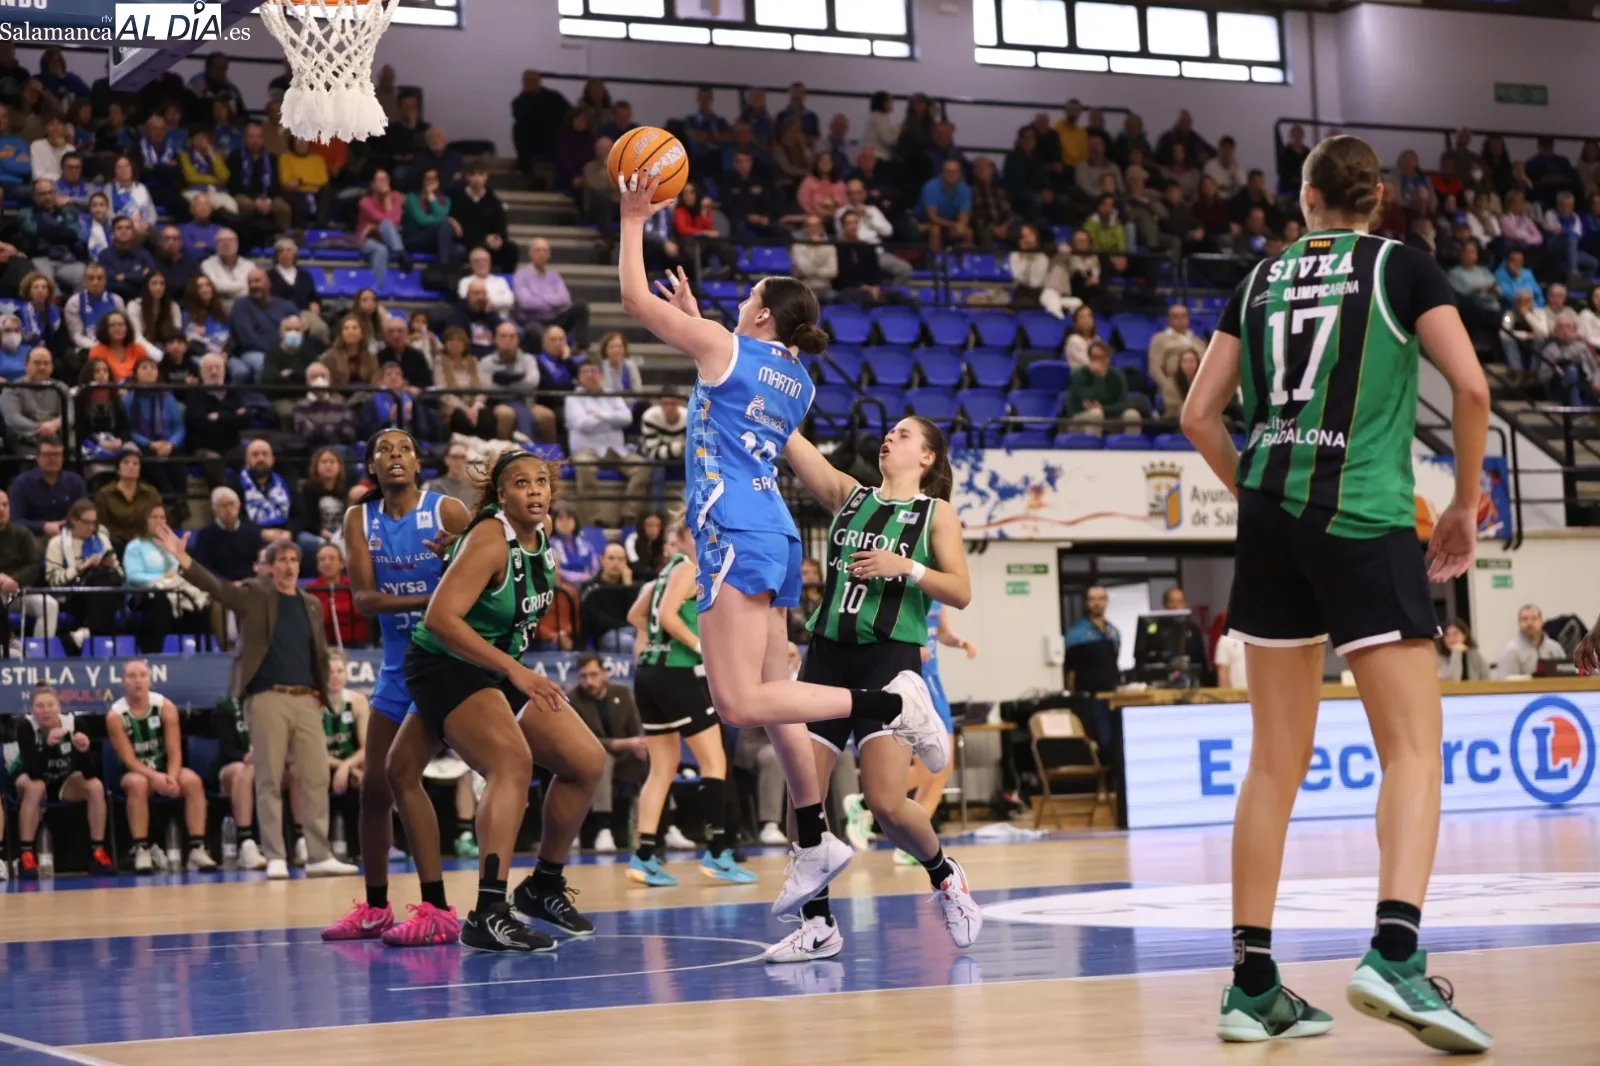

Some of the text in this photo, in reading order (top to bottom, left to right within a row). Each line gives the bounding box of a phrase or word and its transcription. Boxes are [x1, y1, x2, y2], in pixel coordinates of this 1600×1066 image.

[1266, 251, 1354, 283] SIVKA
[1268, 304, 1339, 406] 17
[758, 366, 802, 399] MARTÍN
[1260, 428, 1345, 448] BADALONA
[1191, 508, 1209, 527] de
[833, 528, 909, 558] GRIFOLS
[838, 581, 868, 614] 10
[85, 664, 101, 688] Y
[555, 661, 571, 683] Y
